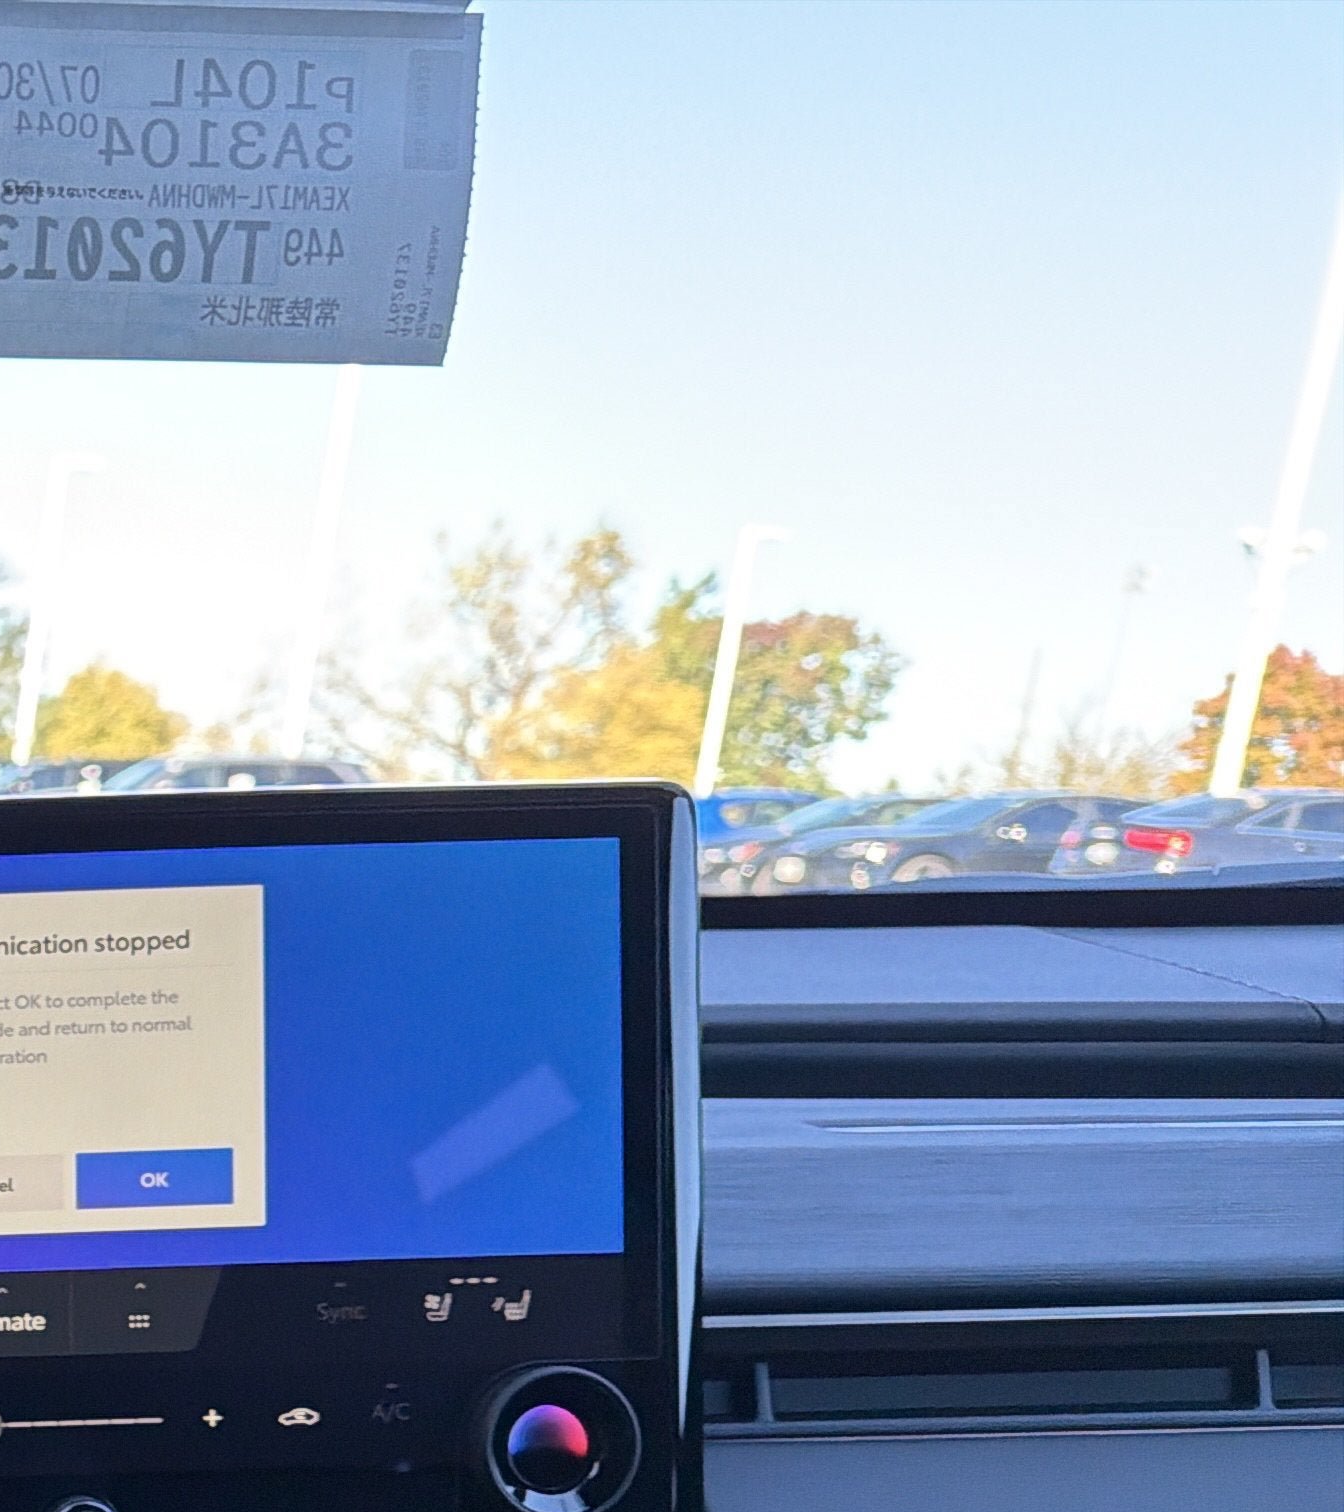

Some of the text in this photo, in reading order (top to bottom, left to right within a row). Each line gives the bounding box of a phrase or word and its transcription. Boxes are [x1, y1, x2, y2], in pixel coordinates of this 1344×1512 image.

[94, 929, 191, 955] stopped
[14, 994, 42, 1010] OK
[45, 994, 64, 1009] to
[66, 991, 148, 1011] complete
[151, 990, 179, 1005] the
[18, 1021, 50, 1037] and
[55, 1020, 106, 1035] return
[110, 1019, 128, 1034] to
[132, 1016, 192, 1033] normal
[140, 1172, 169, 1188] OK
[317, 1301, 367, 1323] Sync
[371, 1402, 411, 1422] A/C
